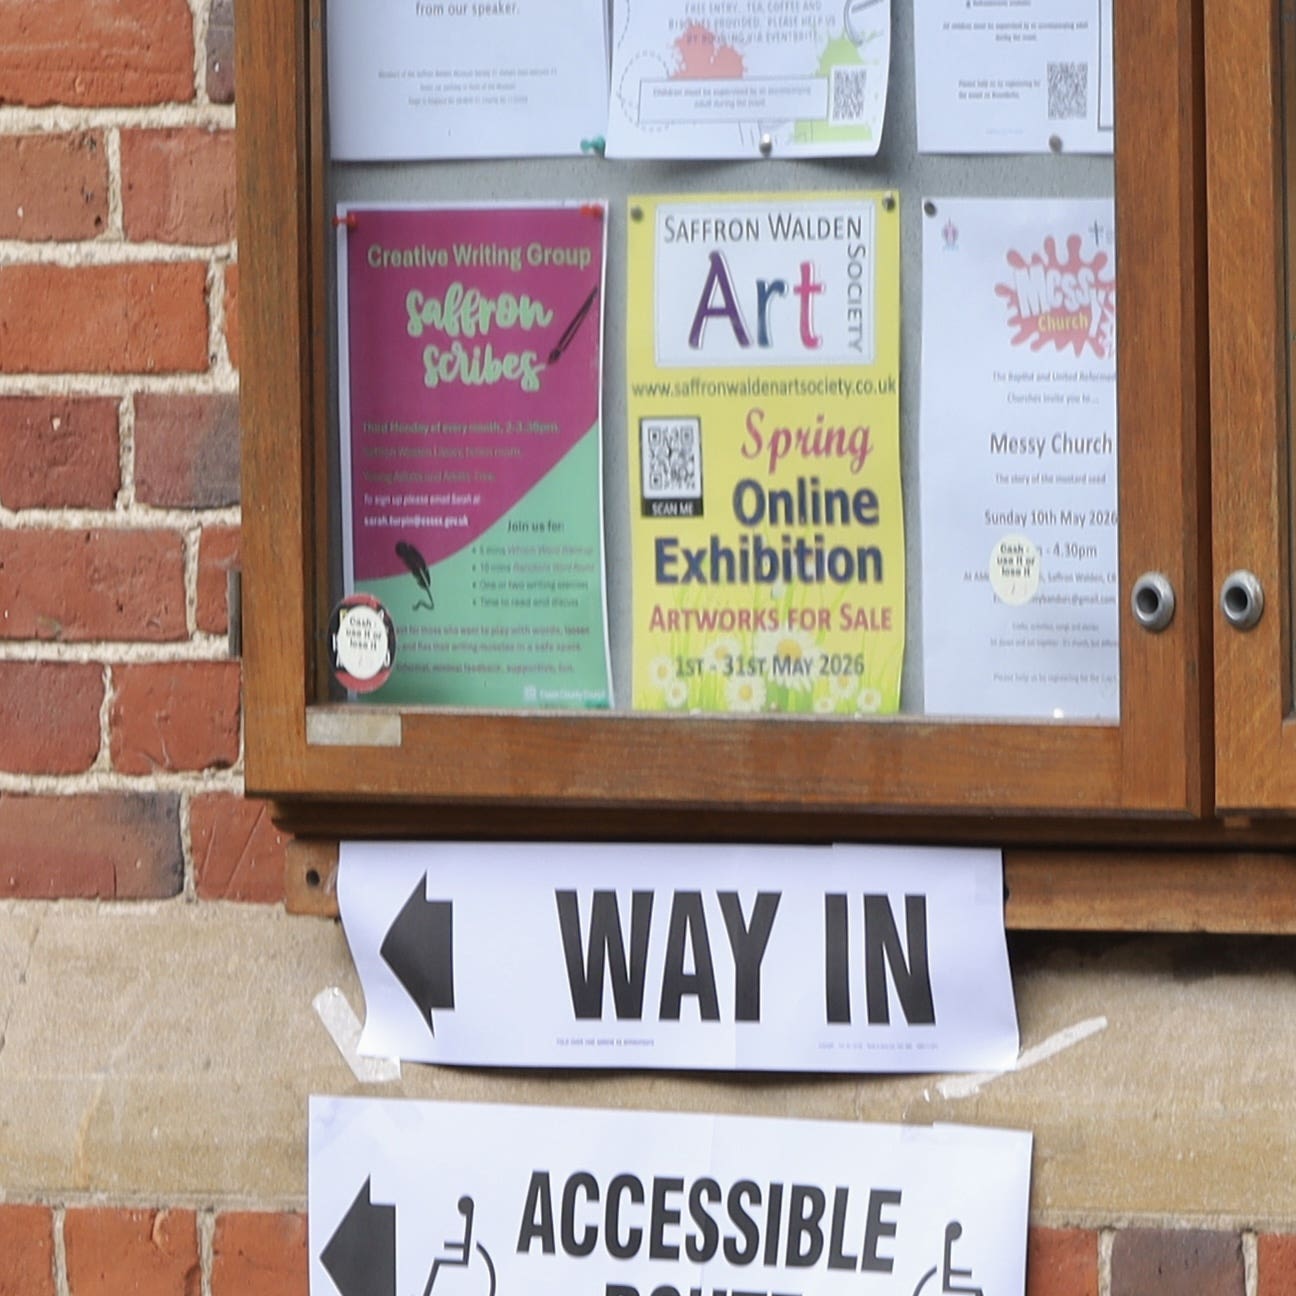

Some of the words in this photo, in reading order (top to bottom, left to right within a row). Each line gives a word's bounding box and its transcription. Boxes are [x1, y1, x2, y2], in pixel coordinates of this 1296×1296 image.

[416, 1, 444, 16] from
[448, 4, 466, 16] our
[664, 215, 760, 243] SAFFRON
[768, 213, 862, 241] WALDEN
[367, 244, 448, 268] Creative
[452, 244, 522, 271] Writing
[526, 243, 591, 270] Group
[688, 250, 824, 350] Art
[847, 244, 866, 352] SOCIETY
[631, 376, 897, 398] www.saffronwaldenartsociety.co.uk
[740, 408, 873, 475] Spring
[990, 434, 1046, 457] Messy
[1051, 432, 1113, 454] Church
[651, 504, 678, 516] SCAN
[680, 504, 694, 516] ME
[732, 476, 879, 526] Online
[507, 521, 529, 532] Join
[532, 523, 544, 532] us
[985, 510, 1027, 527] Sunday
[1031, 509, 1057, 525] 10th
[1060, 510, 1086, 528] May
[654, 534, 883, 584] Exhibition
[997, 556, 1013, 565] use
[1000, 544, 1024, 554] Cash
[1053, 542, 1097, 560] 4.30pm
[1001, 567, 1021, 577] lose
[649, 604, 780, 633] ARTWORKS
[787, 607, 831, 631] FOR
[840, 602, 892, 631] SALE
[554, 888, 783, 1023] WAY
[825, 892, 936, 1027] IN
[515, 1170, 902, 1274] ACCESSIBLE
